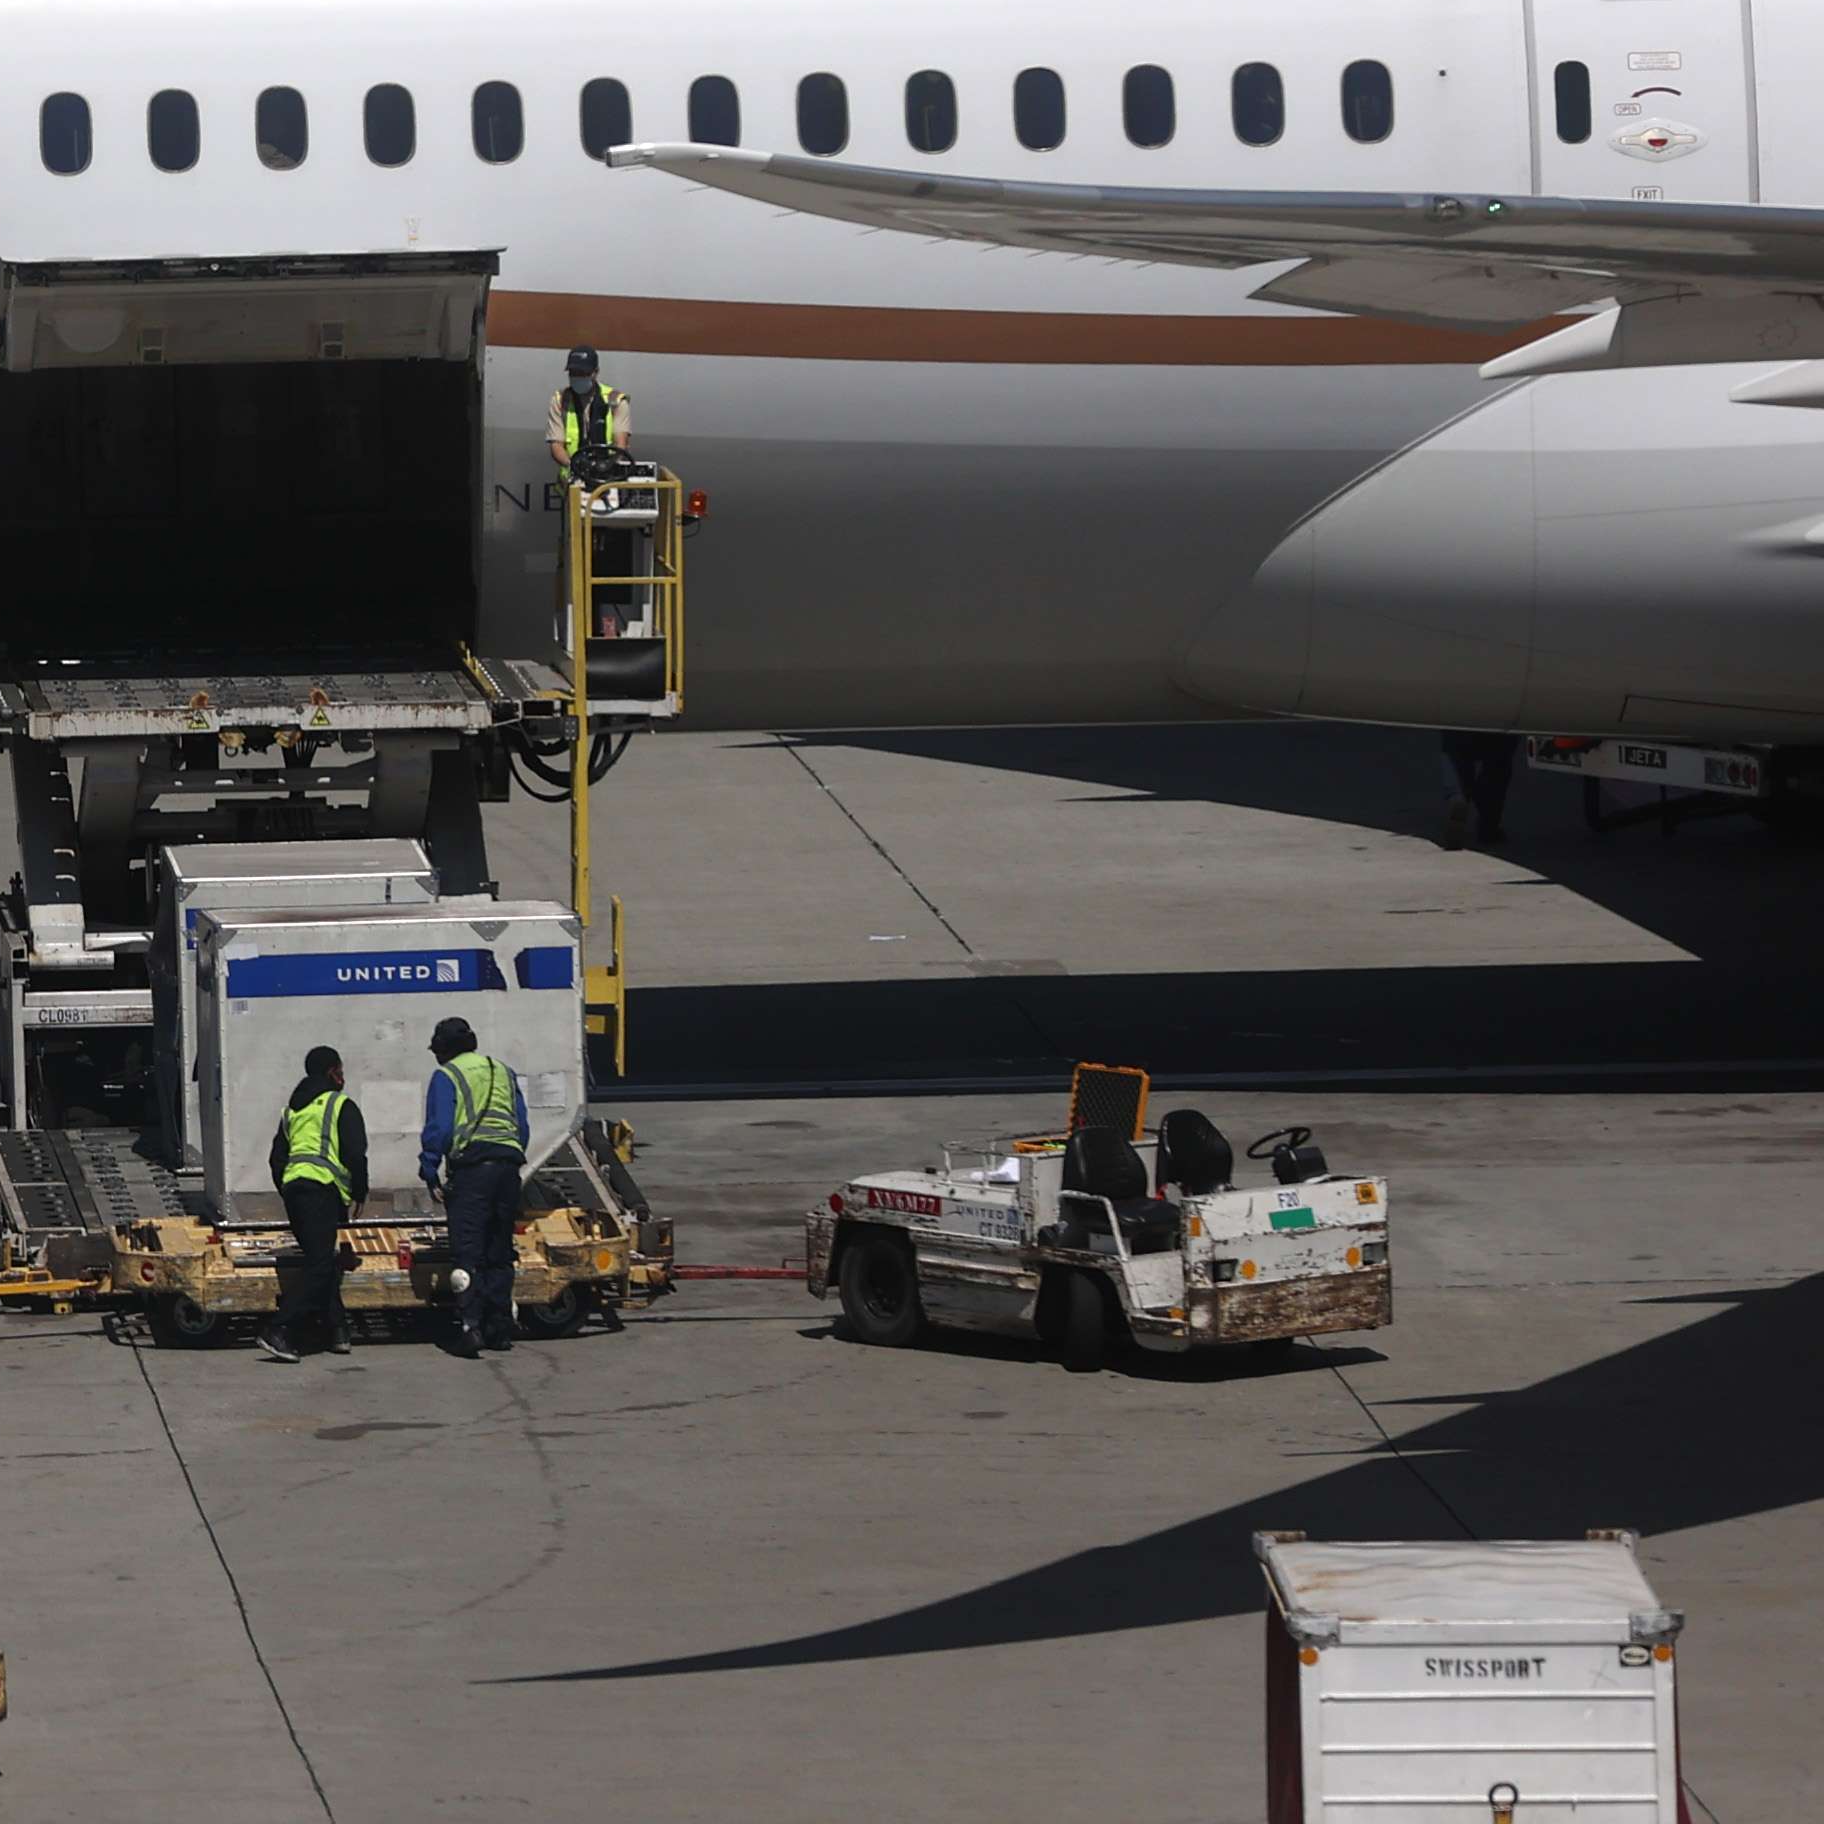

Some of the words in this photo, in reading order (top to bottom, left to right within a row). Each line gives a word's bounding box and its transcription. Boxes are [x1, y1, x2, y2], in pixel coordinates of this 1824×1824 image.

[337, 965, 432, 982] UNITED
[956, 1205, 1005, 1220] UNITED
[1425, 1658, 1547, 1679] SWISSPORT
